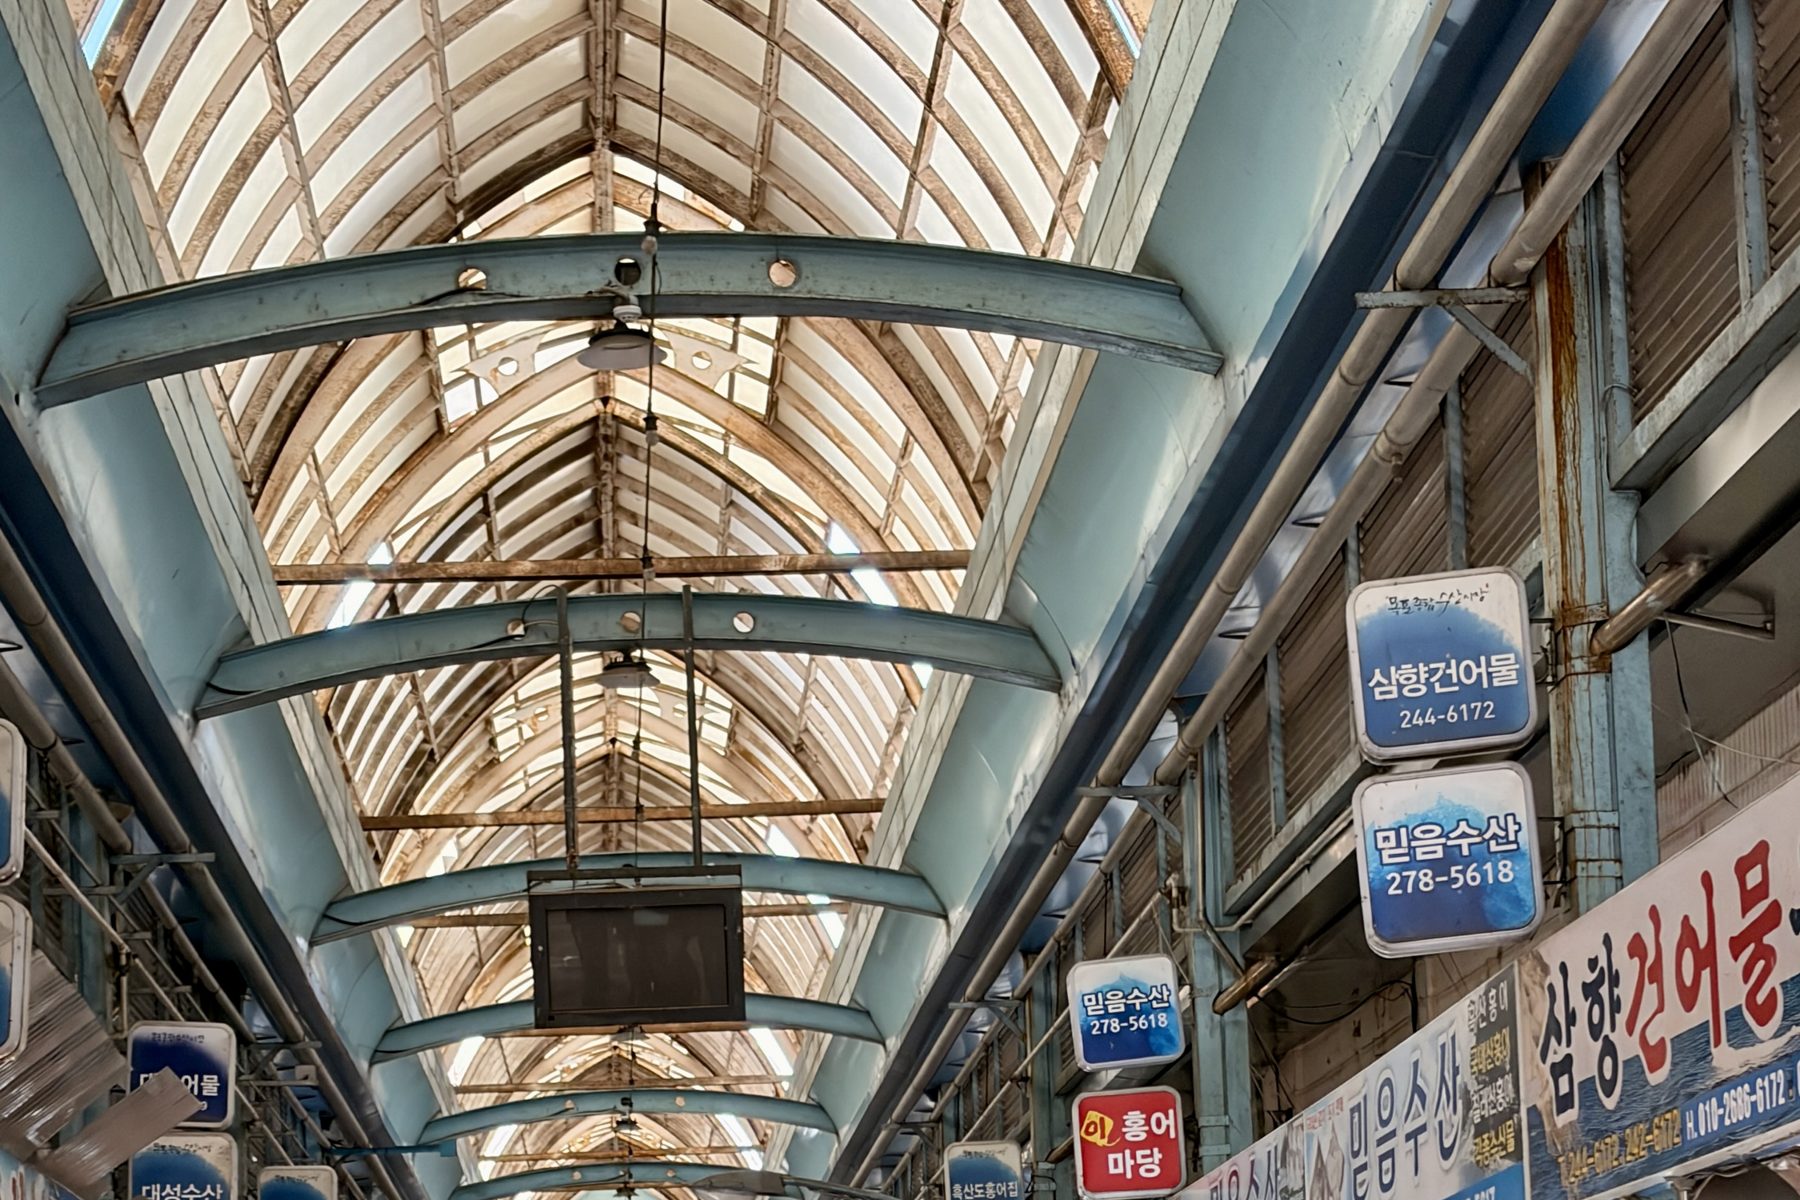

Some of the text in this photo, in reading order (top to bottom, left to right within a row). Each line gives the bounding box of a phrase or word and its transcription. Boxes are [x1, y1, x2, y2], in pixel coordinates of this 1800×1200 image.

[1368, 653, 1520, 700] 삼향건어물
[1400, 702, 1496, 729] 244-6172
[1375, 813, 1522, 865] 믿음수산
[1386, 860, 1515, 896] 278-5618
[1540, 840, 1783, 1117] 삼향건어물
[1082, 985, 1172, 1016] 믿음수산
[1090, 1013, 1169, 1035] 278-5618
[139, 1074, 221, 1096] 어물
[1122, 1108, 1177, 1142] 홍어
[1107, 1148, 1163, 1179] 마당
[952, 1181, 1019, 1200] 흑산도홍어집
